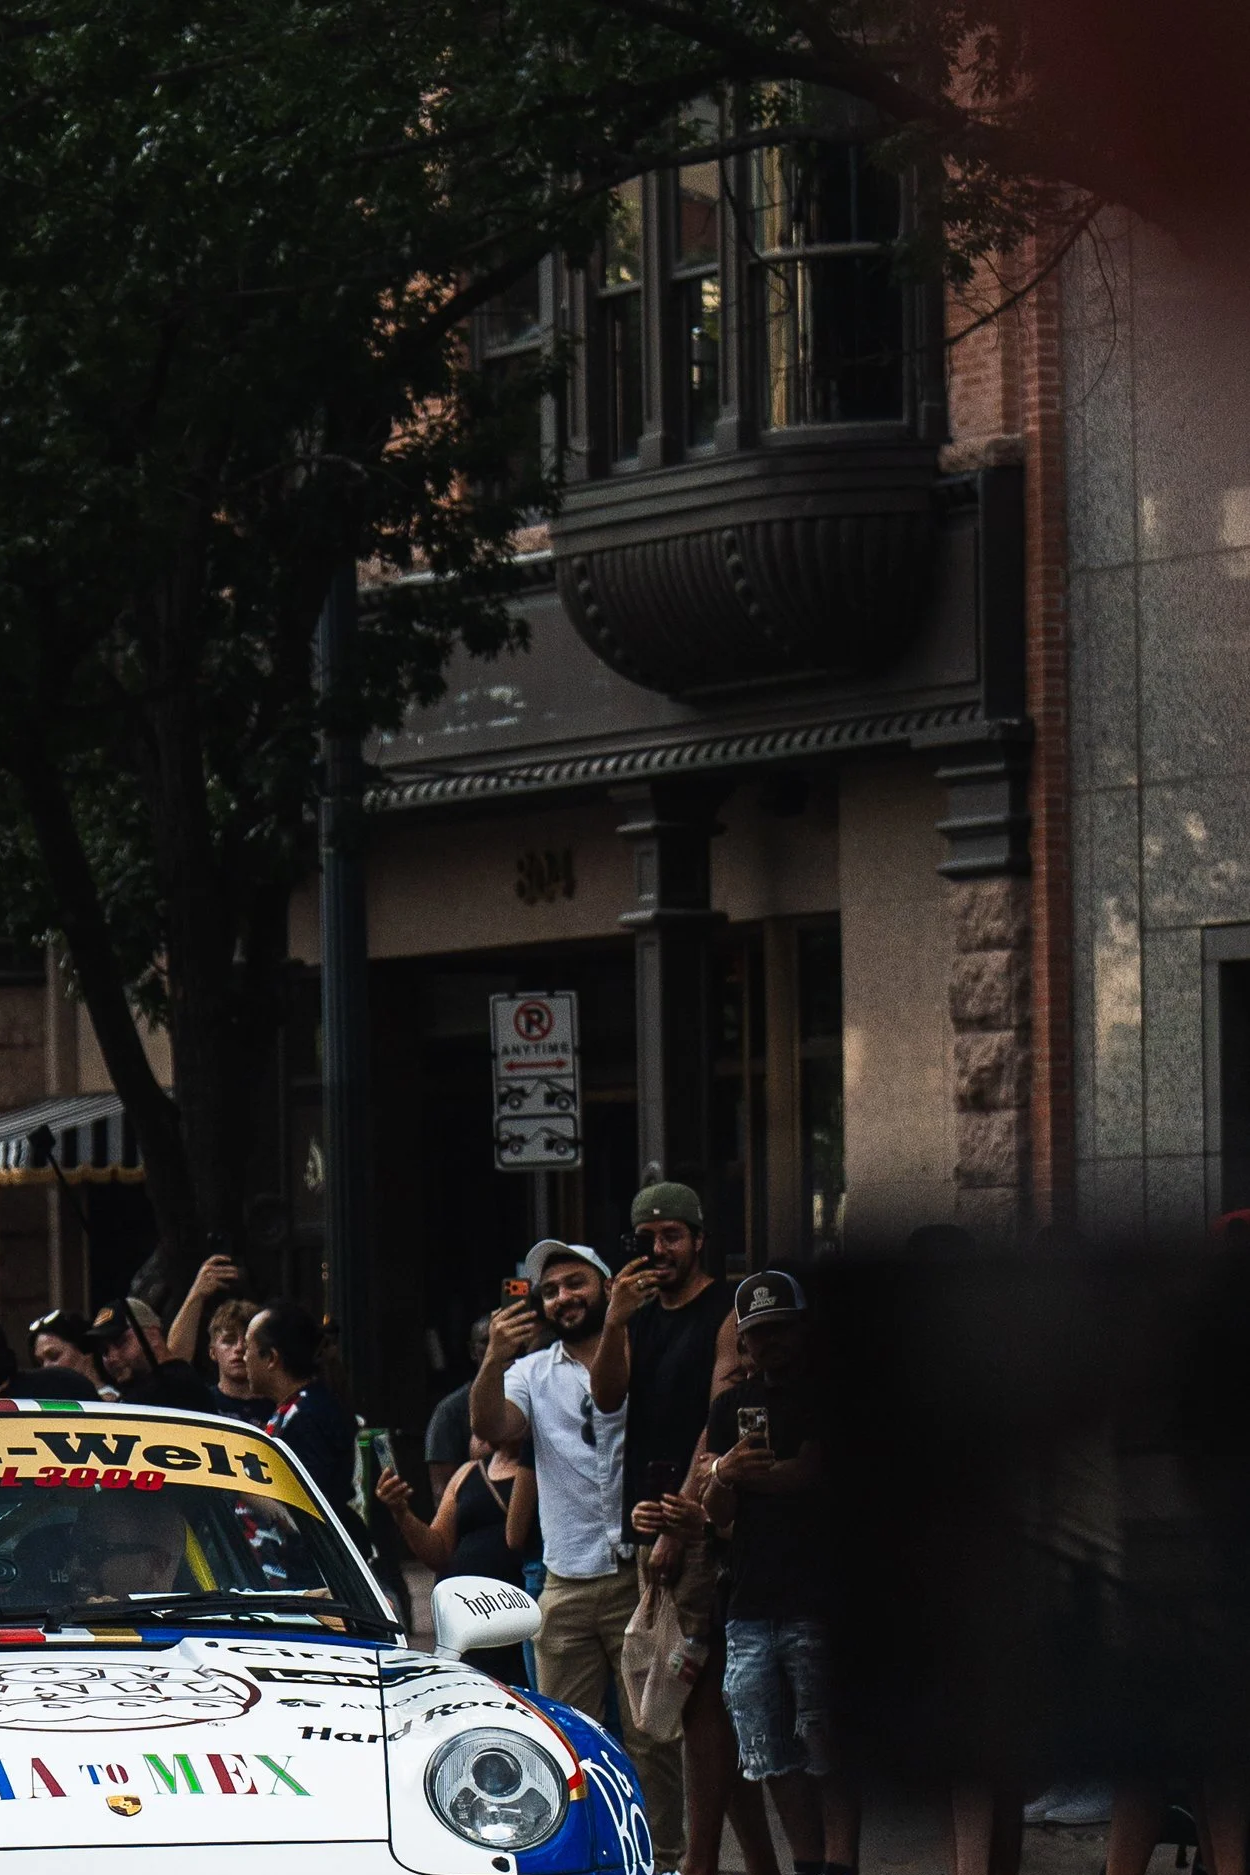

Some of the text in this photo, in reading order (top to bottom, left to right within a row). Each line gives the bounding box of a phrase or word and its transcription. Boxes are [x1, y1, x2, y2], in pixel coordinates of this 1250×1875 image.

[501, 1042, 570, 1056] ANYTIME
[34, 1466, 167, 1491] 3000
[497, 1587, 531, 1610] club
[298, 1701, 535, 1744] Hard Rock
[78, 1763, 130, 1786] TO
[142, 1753, 315, 1797] MEX
